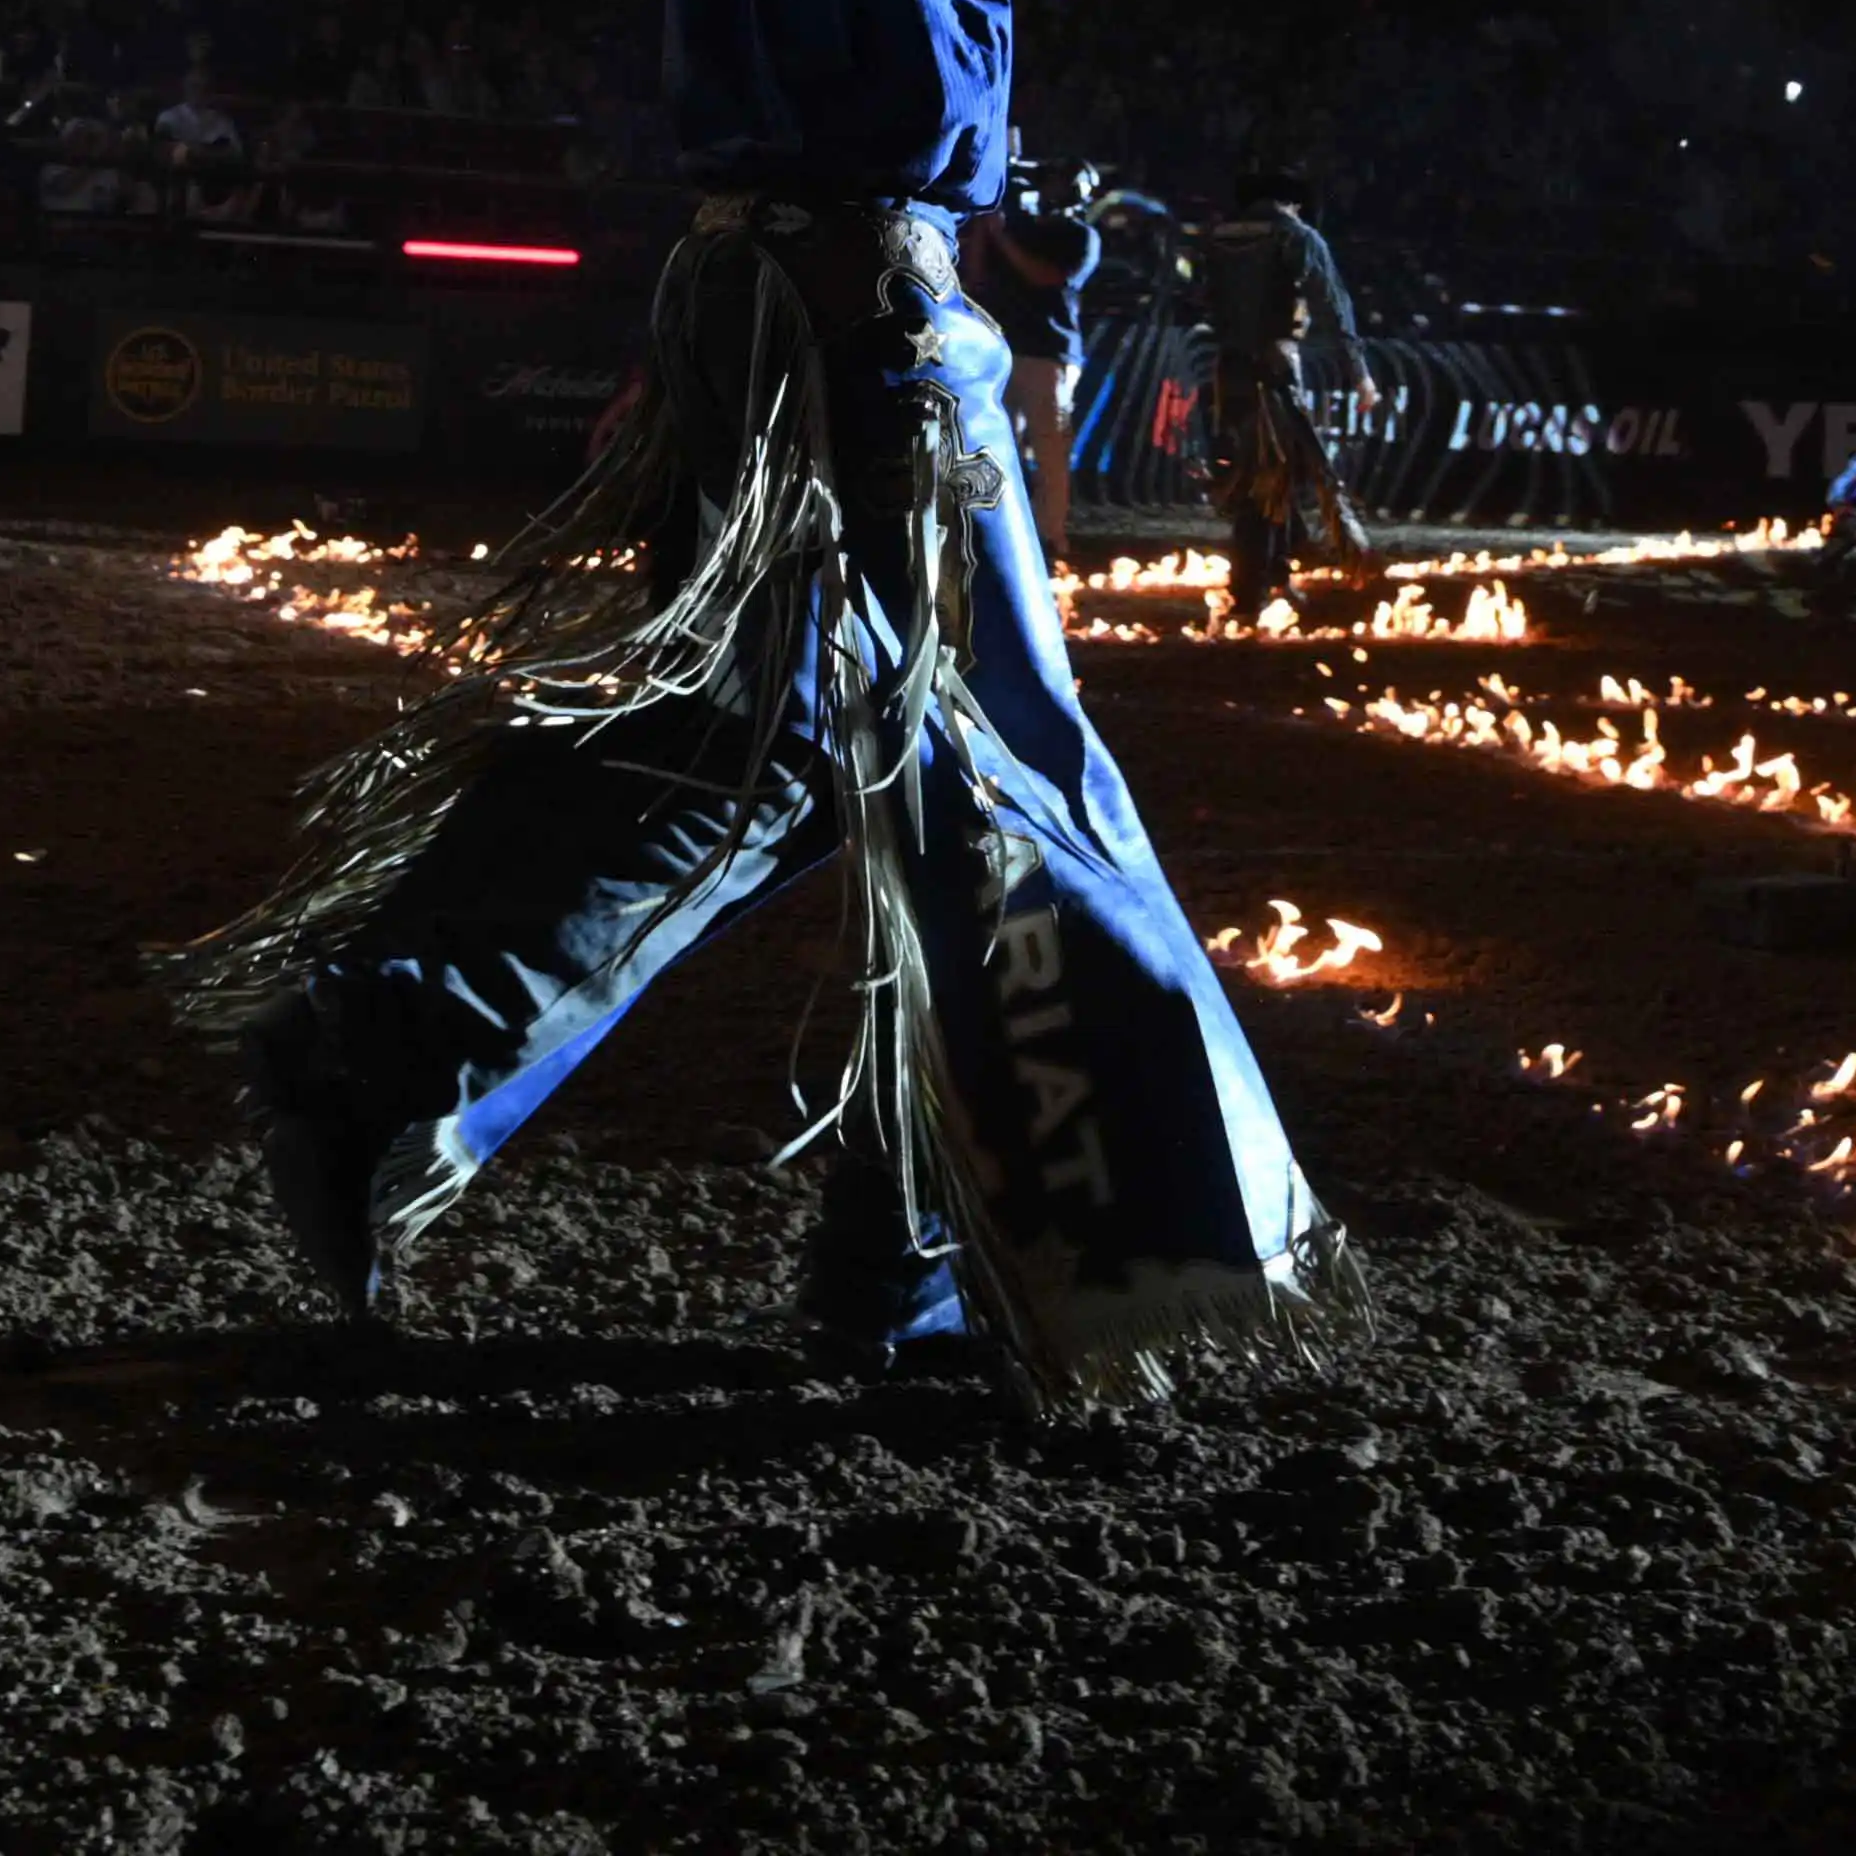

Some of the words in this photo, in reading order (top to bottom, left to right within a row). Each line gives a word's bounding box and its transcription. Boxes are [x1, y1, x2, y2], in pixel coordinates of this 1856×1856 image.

[1448, 399, 1602, 456] LUCAS
[1606, 406, 1685, 456] OIL
[971, 830, 1117, 1206] ARIAT
